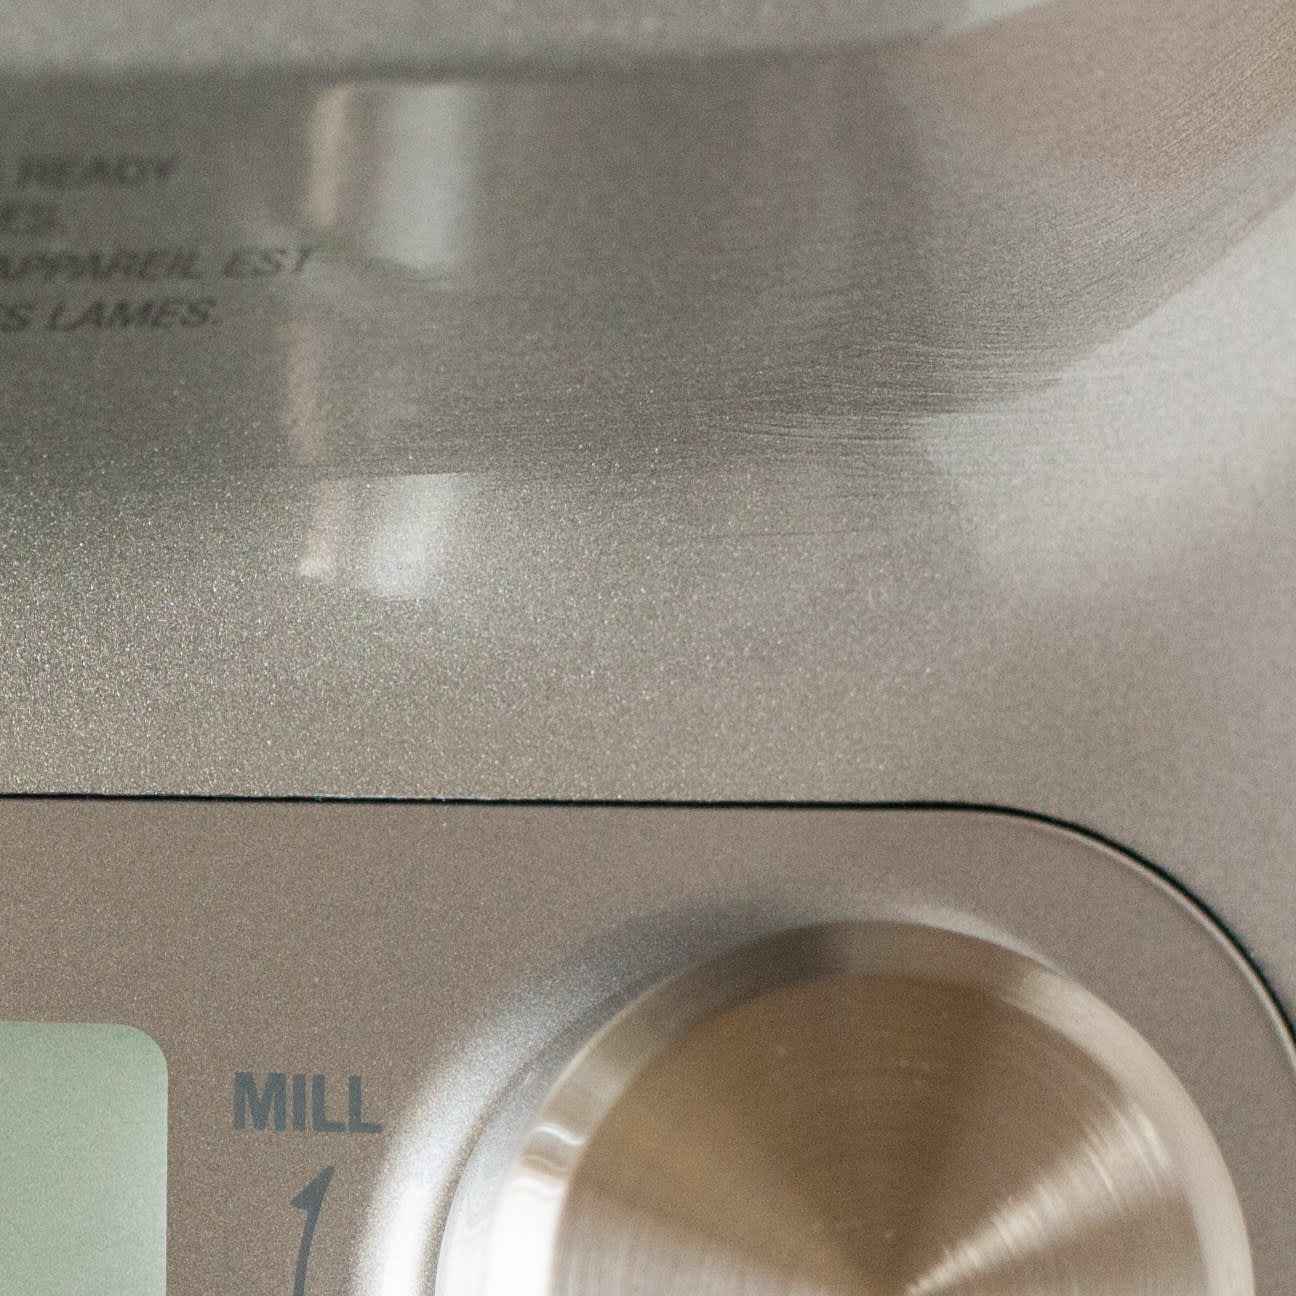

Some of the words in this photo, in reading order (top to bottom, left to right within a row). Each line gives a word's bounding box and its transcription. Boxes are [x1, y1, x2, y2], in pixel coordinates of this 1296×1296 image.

[17, 152, 179, 188] READY
[222, 242, 321, 280] EST
[232, 1071, 383, 1134] MILL
